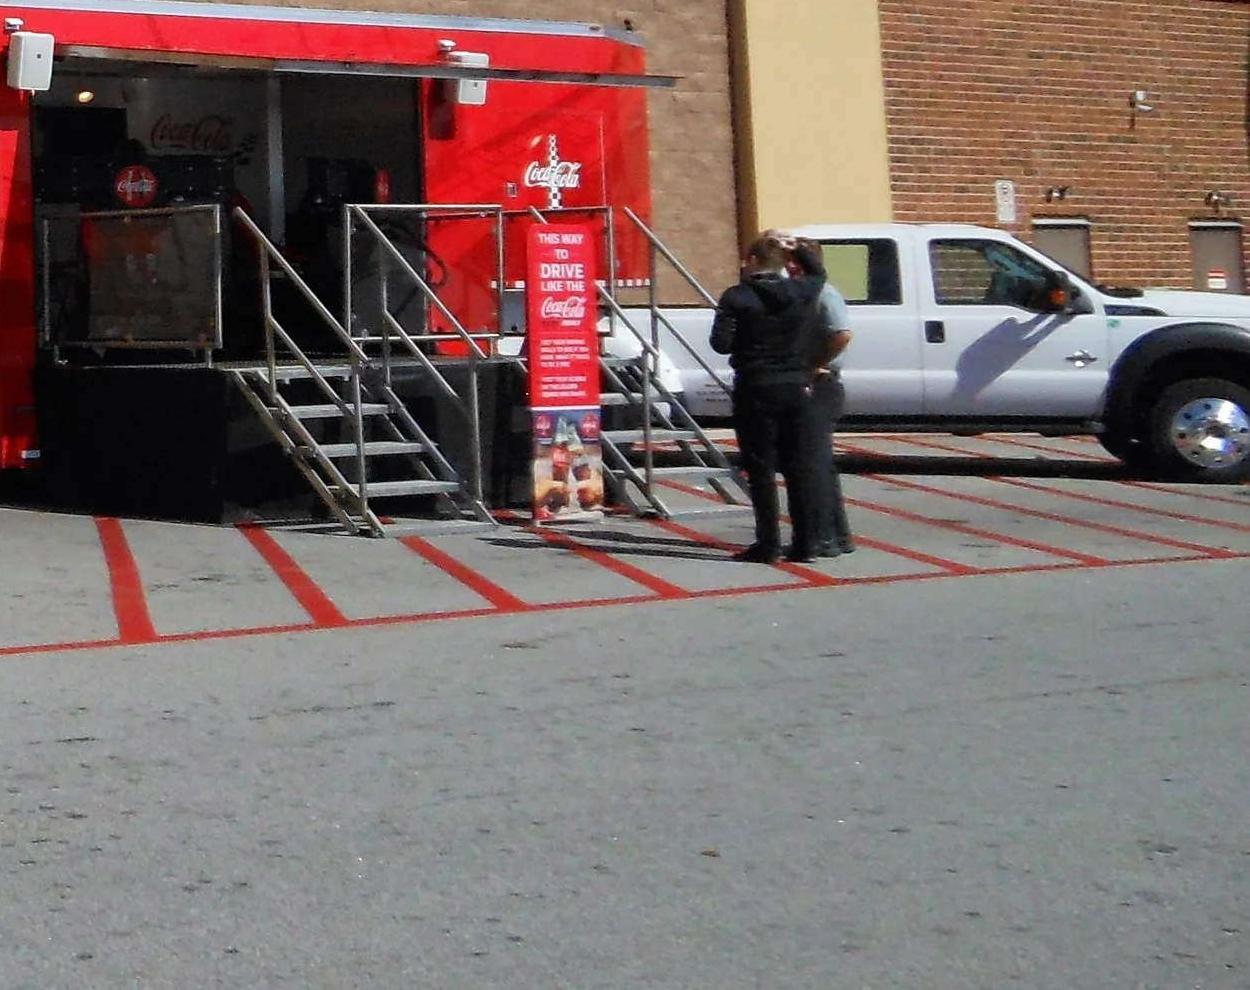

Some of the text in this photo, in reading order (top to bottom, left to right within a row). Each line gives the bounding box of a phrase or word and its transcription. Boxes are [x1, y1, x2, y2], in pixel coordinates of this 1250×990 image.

[537, 233, 583, 244] THIS WAY
[554, 248, 568, 260] TO
[540, 263, 584, 279] DRIVE
[541, 280, 586, 291] LIKE THE
